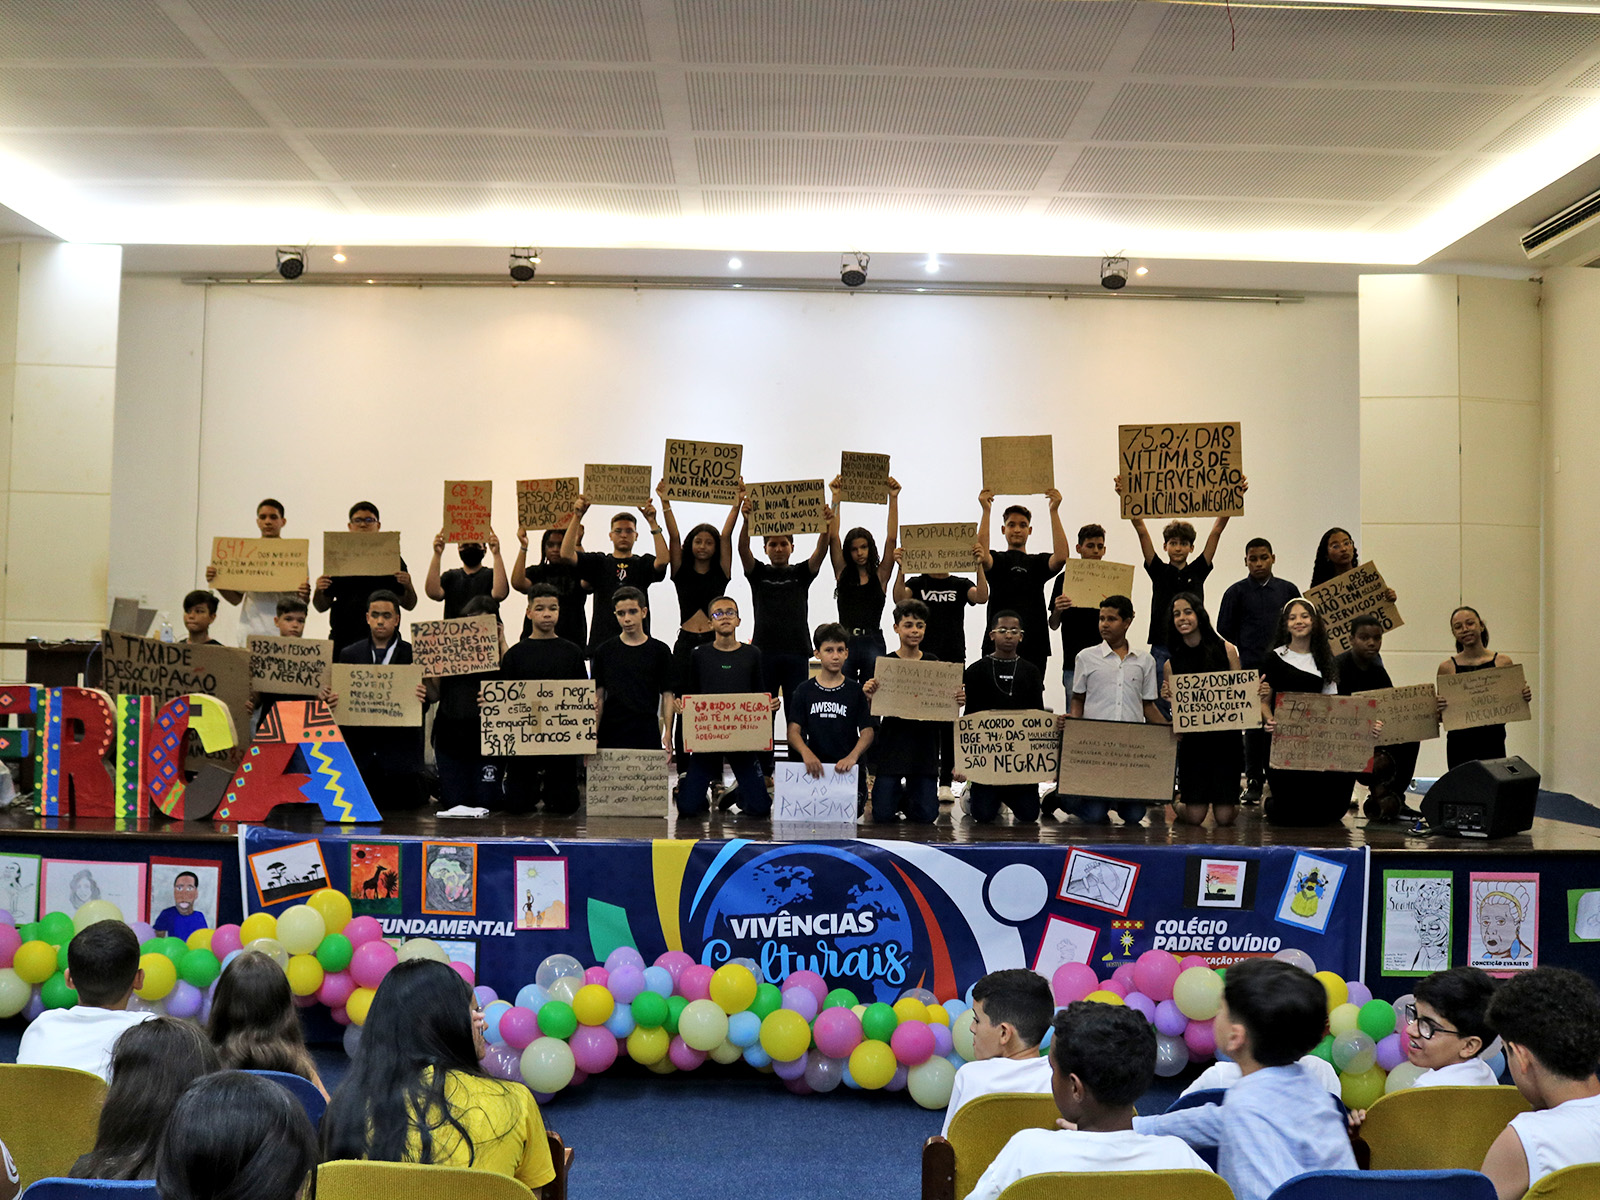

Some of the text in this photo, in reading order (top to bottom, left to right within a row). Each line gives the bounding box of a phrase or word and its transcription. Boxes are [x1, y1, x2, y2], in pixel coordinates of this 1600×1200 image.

[1195, 425, 1235, 450] DAS
[714, 446, 738, 459] DOS
[1208, 450, 1232, 469] DE
[669, 456, 736, 480] NEGROS
[556, 479, 576, 491] DAS
[668, 474, 687, 486] NÃO
[711, 479, 739, 487] ACESSO
[667, 488, 676, 497] A
[677, 488, 711, 499] ENERGIA
[750, 488, 759, 498] A
[760, 484, 784, 497] TAXA
[798, 498, 821, 507] MAIOR
[1202, 485, 1245, 513] NEGRAS
[449, 532, 484, 542] NEGROS
[905, 525, 976, 541] A POPULAÇÃO
[904, 550, 933, 560] NEGRA
[1346, 571, 1380, 593] NEGROS
[1349, 568, 1368, 583] DOS
[920, 589, 957, 603] VANS
[449, 621, 480, 636] DAS
[104, 632, 192, 667] A TAXA DE
[476, 652, 495, 662] DE
[884, 665, 893, 674] A
[270, 670, 321, 689] NEGRAS
[1208, 674, 1228, 688] DOS
[350, 690, 392, 701] NEGROS
[537, 683, 554, 698] dos
[1175, 691, 1190, 704] OS
[1191, 688, 1215, 703] NÃO
[538, 704, 549, 713] na
[719, 701, 736, 712] DOS
[810, 702, 848, 717] AWESOME
[1177, 702, 1213, 713] ACESSO
[495, 713, 538, 732] enquanto
[545, 719, 554, 727] a
[551, 713, 579, 726] taxa
[959, 718, 1053, 731] DE ACORDO COM O
[1179, 715, 1199, 728] DE
[481, 728, 498, 741] tre
[521, 727, 572, 744] brancos
[576, 731, 582, 740] é
[584, 727, 597, 741] de
[960, 732, 982, 745] IBGE
[1006, 730, 1026, 742] DAS
[1004, 742, 1016, 752] DE
[964, 755, 988, 769] SÃO
[994, 752, 1058, 774] NEGRAS
[731, 909, 875, 940] VIVÊNCIAS
[1154, 916, 1229, 936] COLÉGIO
[1152, 932, 1282, 953] PADRE OVÍDIO
[701, 938, 910, 986] Clturais
